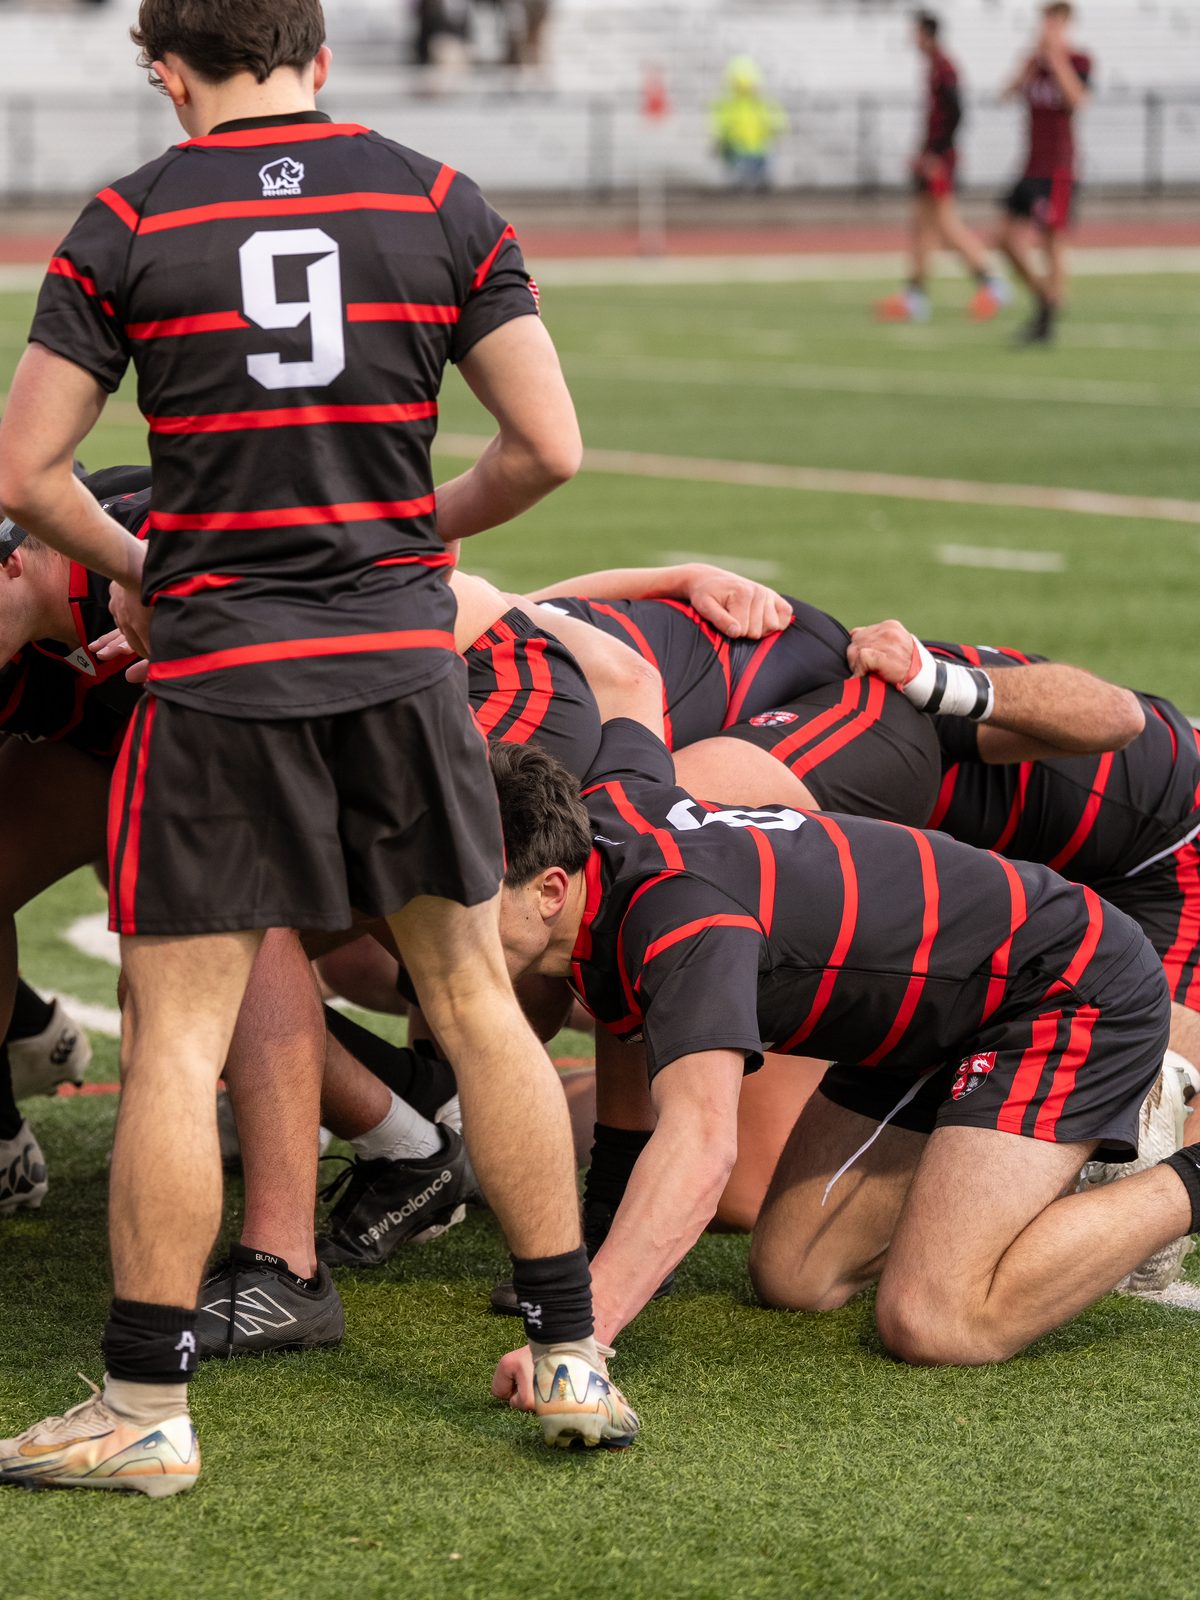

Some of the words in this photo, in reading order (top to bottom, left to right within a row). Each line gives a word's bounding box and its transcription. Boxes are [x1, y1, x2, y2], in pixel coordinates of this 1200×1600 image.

[262, 188, 302, 196] RHINO
[238, 227, 346, 391] 9
[358, 1218, 390, 1246] new
[386, 1169, 453, 1226] balance
[255, 1253, 278, 1265] BURN
